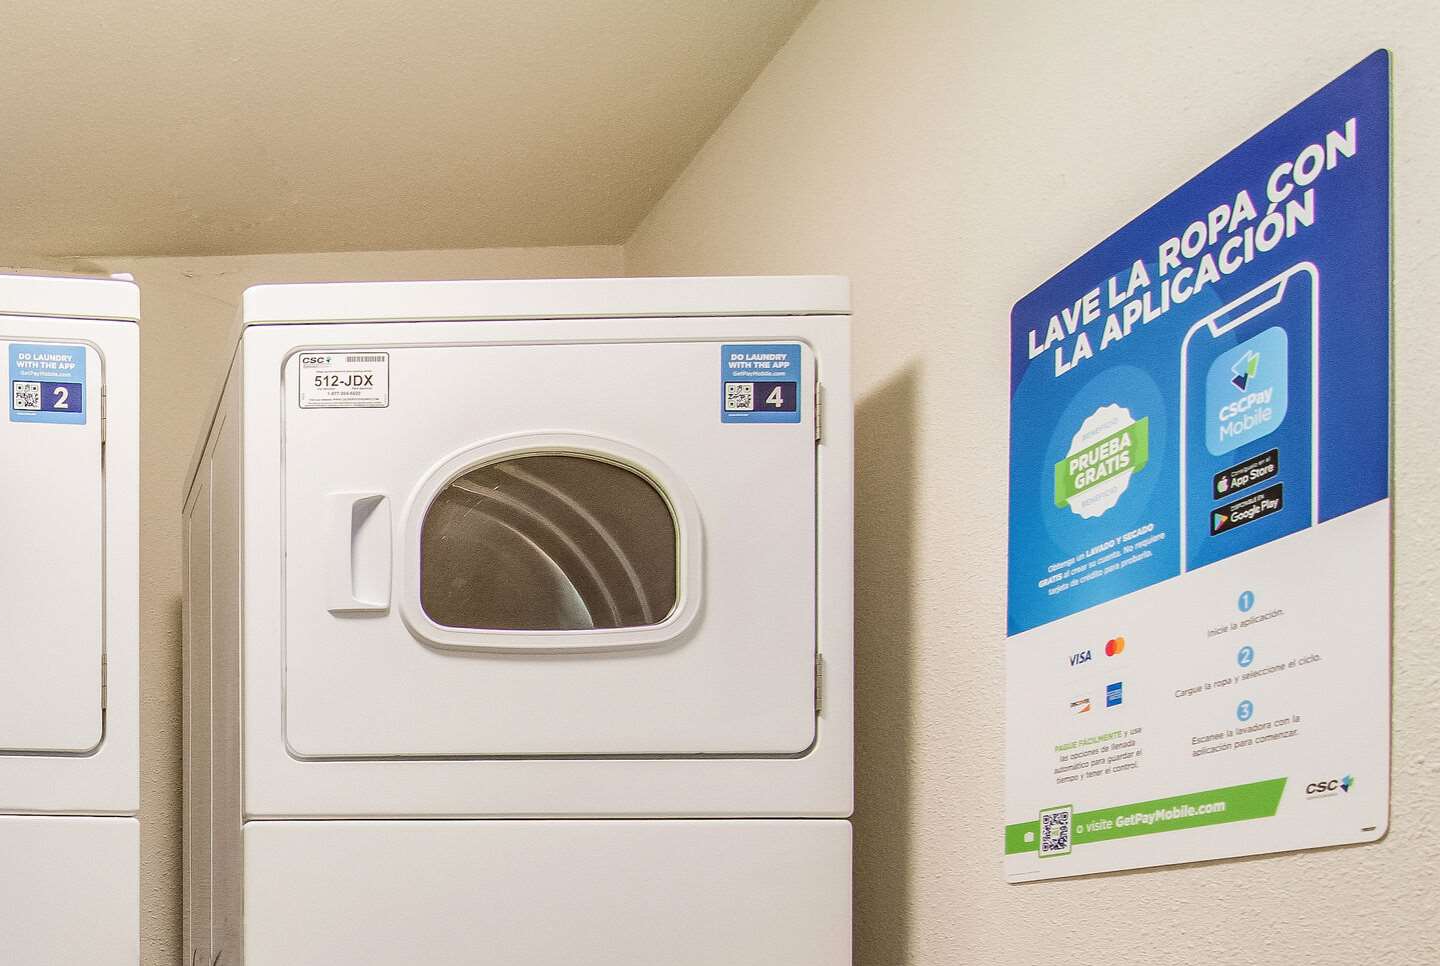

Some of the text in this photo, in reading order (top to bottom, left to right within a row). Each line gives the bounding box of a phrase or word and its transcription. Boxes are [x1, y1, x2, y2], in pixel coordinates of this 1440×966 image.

[1028, 117, 1356, 360] LAVE LA ROPA CON
[1054, 188, 1314, 378] LA APLICACIÓN
[40, 361, 57, 369] THE
[59, 362, 76, 370] APP
[728, 361, 790, 369] WITH THE APP
[314, 374, 373, 387] 512-JDX
[53, 386, 68, 409] 2
[765, 386, 784, 408] 4
[1219, 386, 1272, 421] CSCPay
[1219, 407, 1272, 442] Mobile
[1069, 432, 1131, 475] PRUEBA
[1074, 450, 1130, 489] GRATIS
[1230, 463, 1274, 489] App Store
[1230, 497, 1278, 523] Google Play
[1085, 539, 1115, 558] LAVADO
[1115, 536, 1122, 545] Y
[1122, 523, 1154, 542] SECADO
[1038, 573, 1063, 588] GRATIS
[1070, 564, 1087, 576] crear
[1123, 544, 1134, 555] No
[1070, 579, 1079, 588] de
[1103, 563, 1120, 575] para
[1242, 593, 1249, 608] 1
[1208, 626, 1228, 637] Inicie
[1230, 623, 1237, 631] la
[1070, 649, 1092, 667] VISA
[1241, 649, 1251, 664] 2
[1175, 685, 1202, 698] Cargue
[1204, 682, 1211, 690] la
[1213, 677, 1232, 688] ropa
[1242, 663, 1286, 681] seleccione
[1288, 660, 1296, 668] el
[1298, 653, 1322, 666] ciclo.
[1241, 703, 1250, 718] 3
[1192, 714, 1300, 745] Escanee la lavadora con la
[1101, 745, 1109, 753] de
[1192, 742, 1232, 757] aplicación
[1234, 738, 1253, 748] para
[1091, 758, 1105, 767] para
[1056, 774, 1079, 785] tiempo
[1306, 779, 1338, 794] CSC
[1075, 801, 1226, 834] o visite GetPayMobile.com
